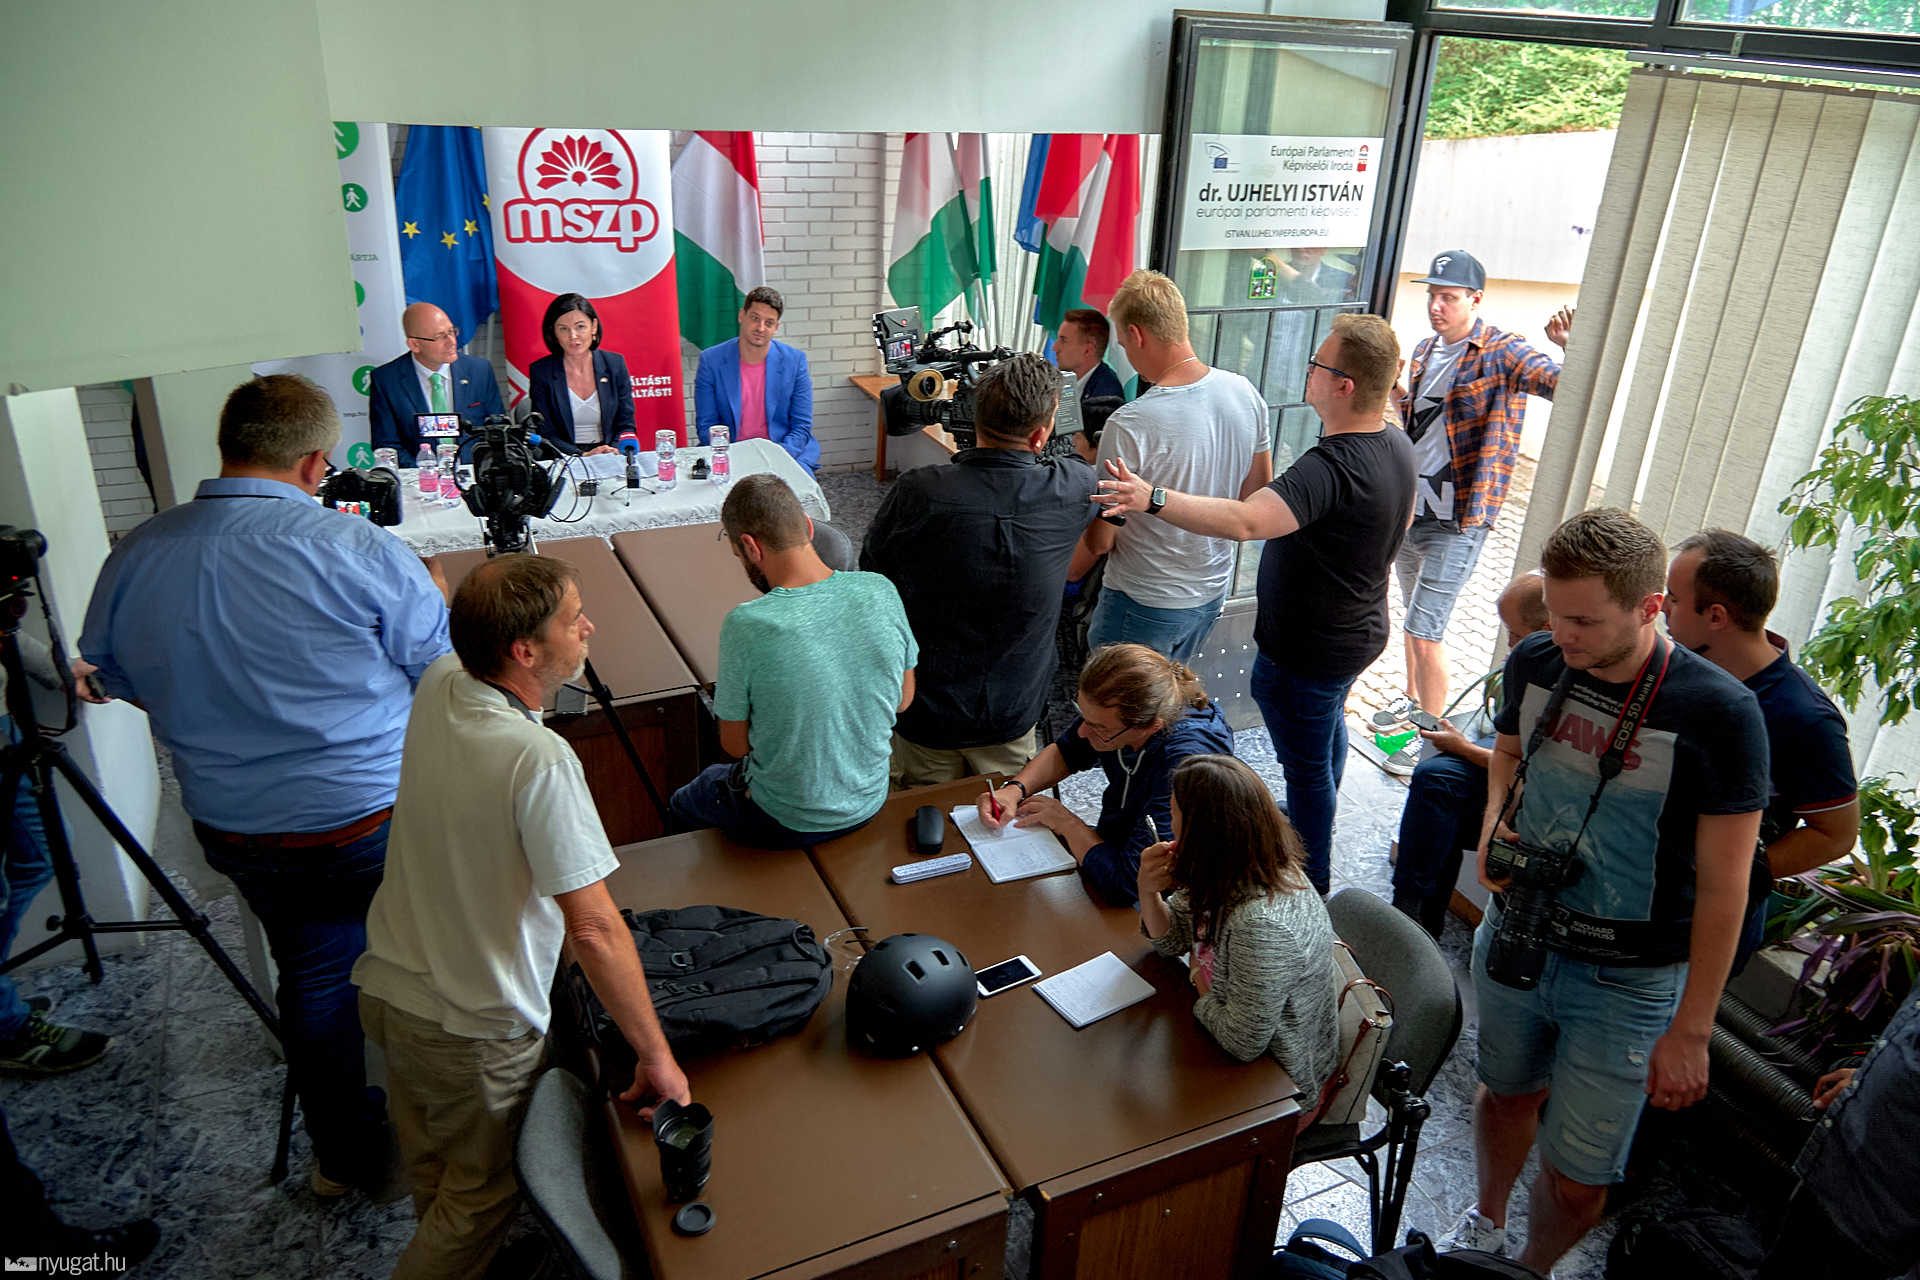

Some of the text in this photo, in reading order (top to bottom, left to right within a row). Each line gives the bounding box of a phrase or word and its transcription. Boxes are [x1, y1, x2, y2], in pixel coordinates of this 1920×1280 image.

[1271, 145, 1306, 159] Európai
[1330, 160, 1354, 171] Iroda
[1199, 181, 1364, 202] dr. UJHELYI ISTVÁN
[1196, 206, 1244, 220] európai
[1245, 206, 1309, 220] parlamenti
[504, 199, 659, 252] mszp
[629, 374, 672, 387] ÁLTÁST!
[630, 386, 673, 399] ÁLTÁST!
[1612, 719, 1635, 751] EOS
[1626, 702, 1642, 720] 5D
